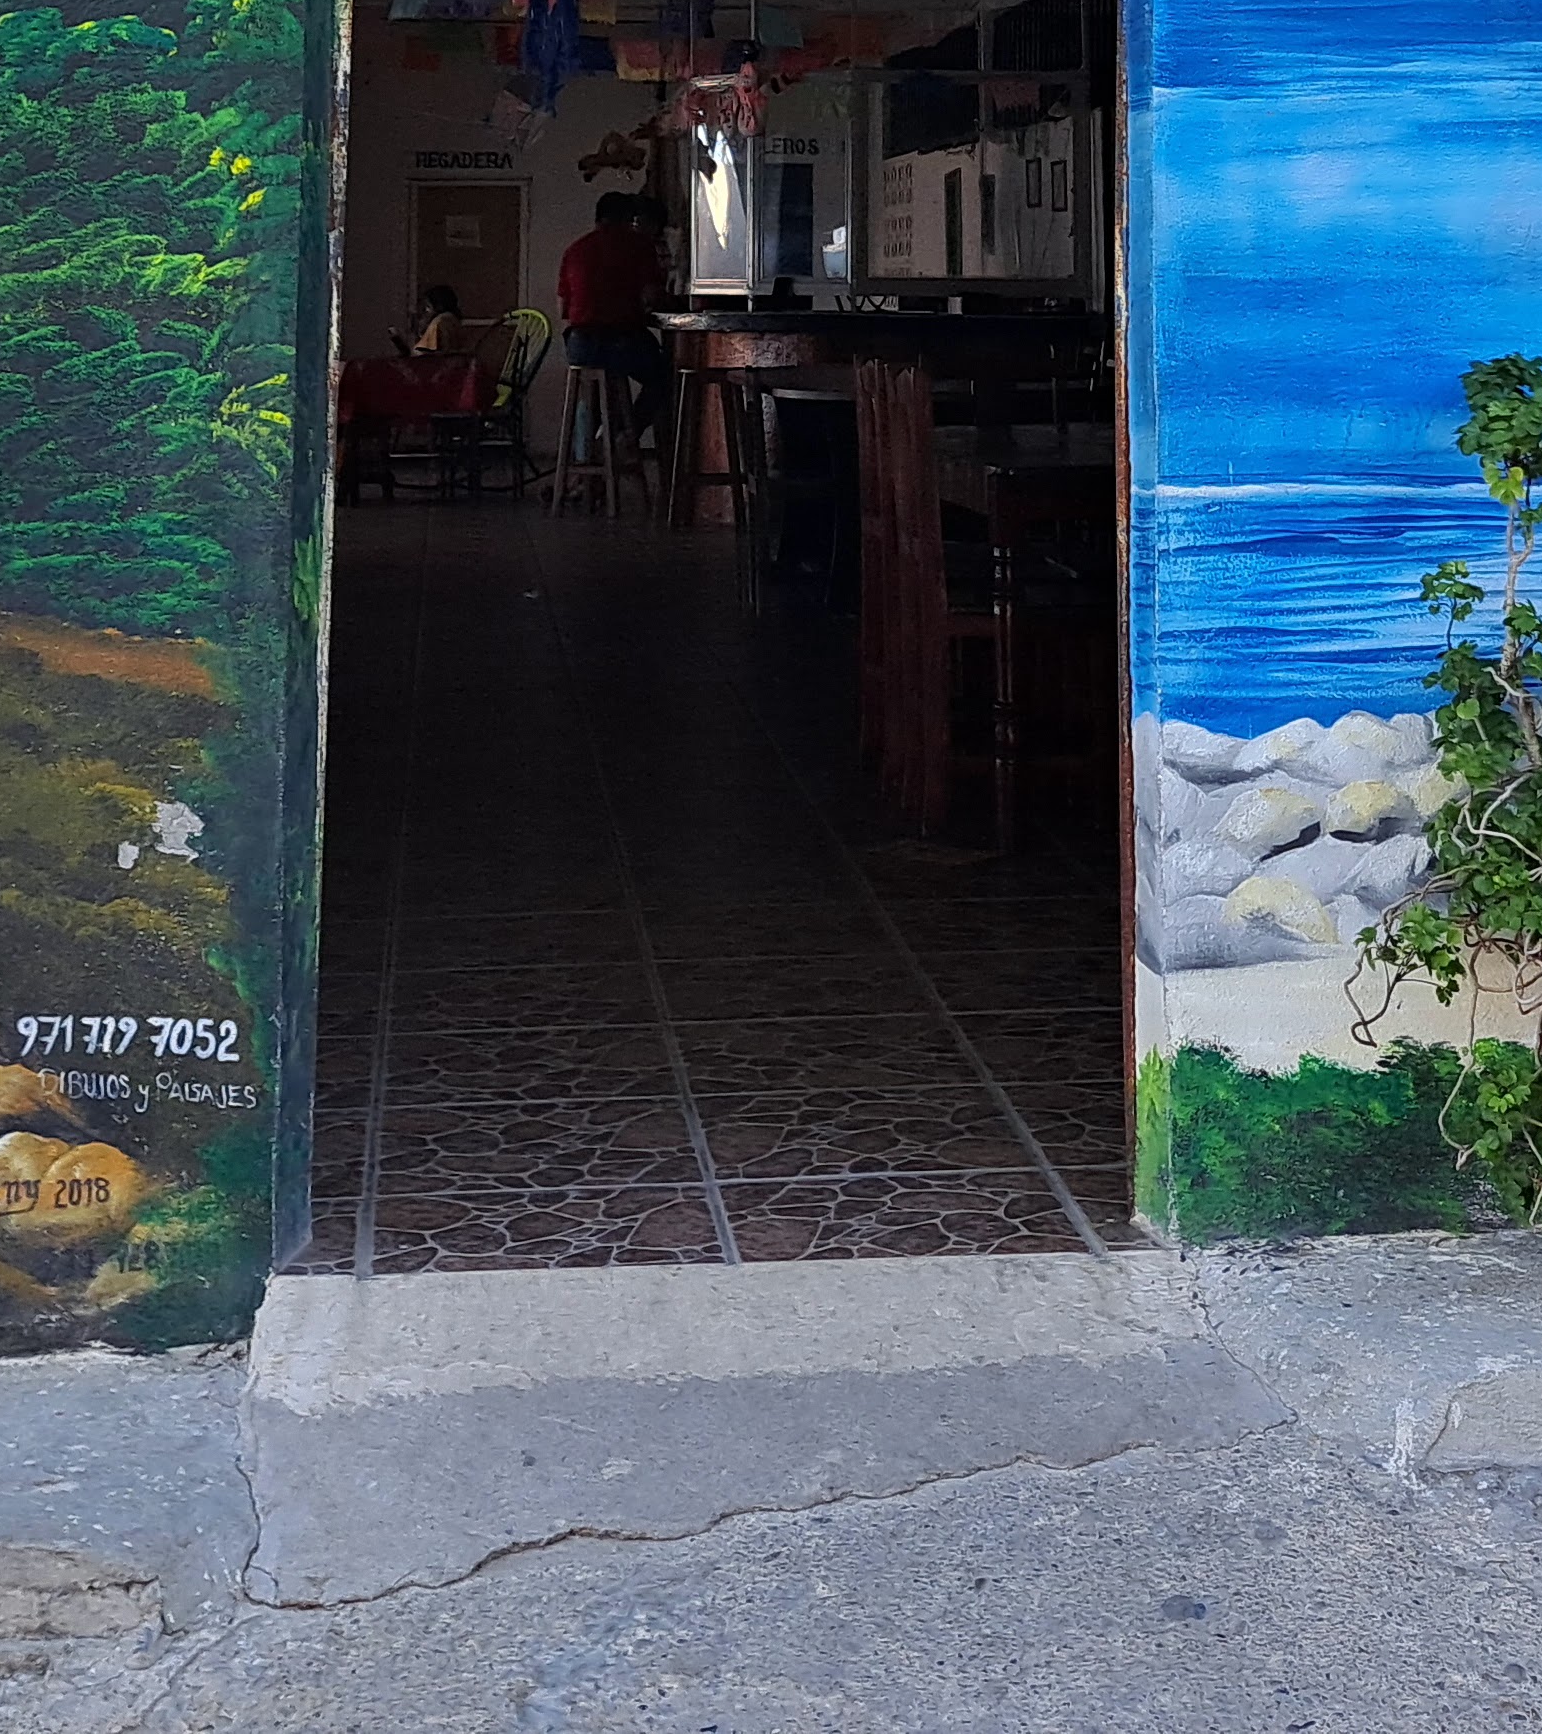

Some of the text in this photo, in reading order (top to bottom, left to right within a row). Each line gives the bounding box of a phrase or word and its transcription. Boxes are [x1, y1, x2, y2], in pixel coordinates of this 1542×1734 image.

[415, 150, 515, 170] REGADERA
[16, 1014, 241, 1063] 971 719 7052
[37, 1067, 132, 1100] DIBUJOS
[54, 1176, 111, 1209] 2018
